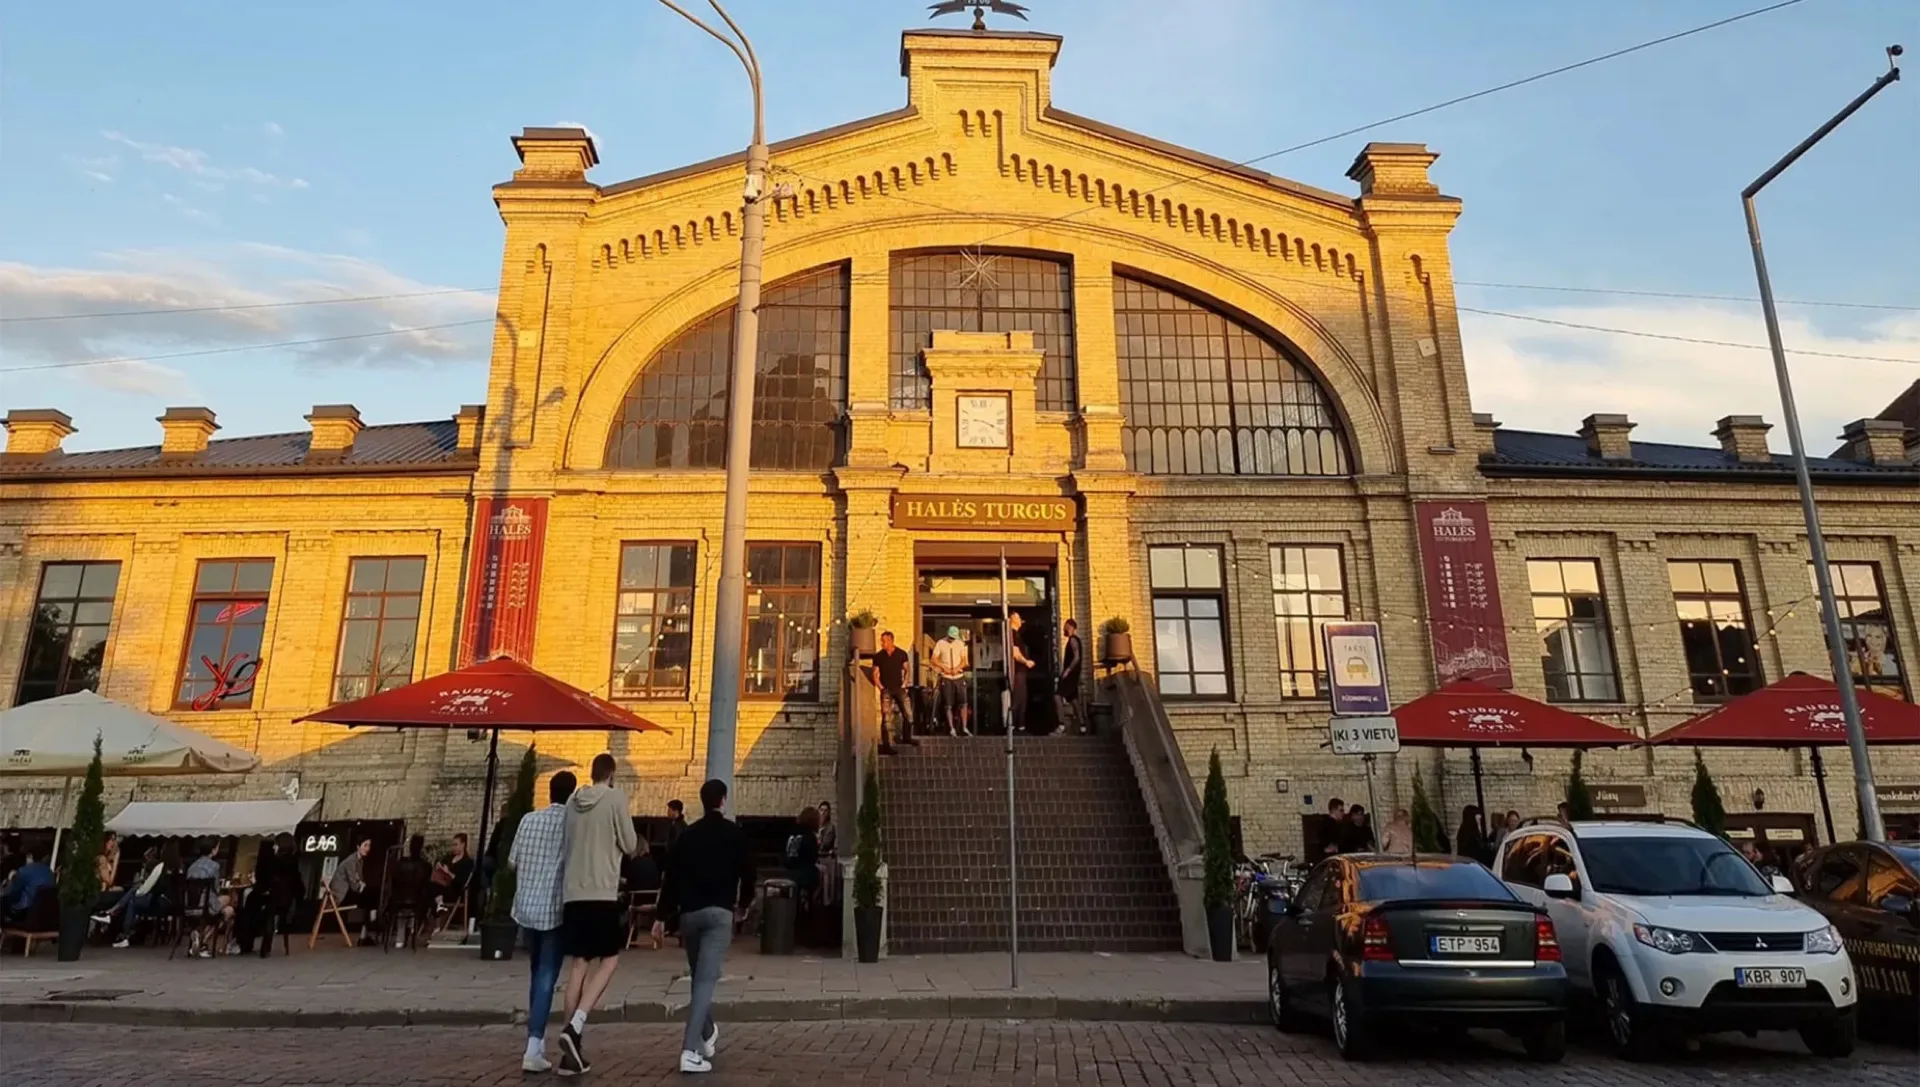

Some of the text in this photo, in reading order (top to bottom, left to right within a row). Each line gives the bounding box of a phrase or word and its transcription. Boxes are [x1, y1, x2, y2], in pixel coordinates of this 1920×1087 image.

[907, 498, 1067, 520] HALĖS TURGUS
[1333, 728, 1397, 742] IKI 3 VIETŲ
[305, 834, 338, 852] BAR
[1438, 937, 1498, 951] ETP 954
[1744, 970, 1803, 983] KBR 907
